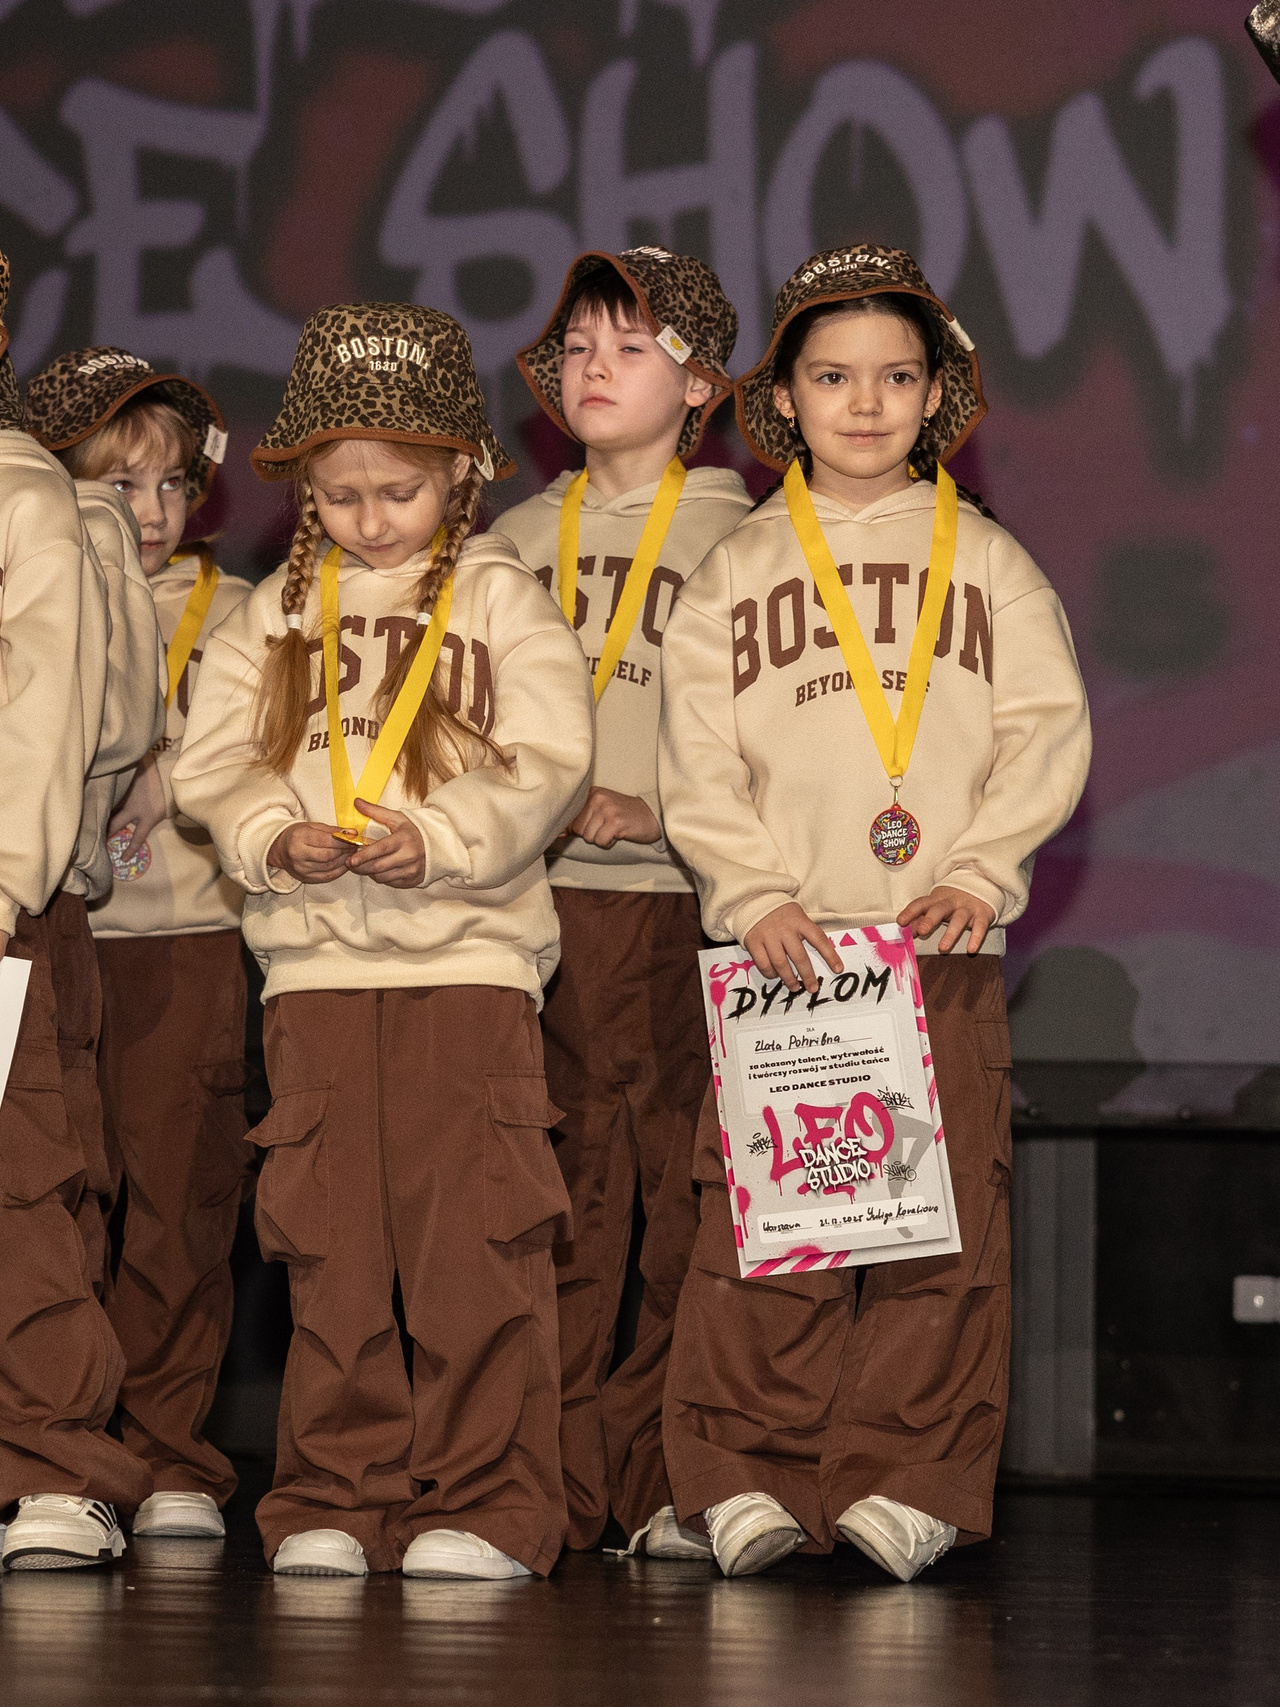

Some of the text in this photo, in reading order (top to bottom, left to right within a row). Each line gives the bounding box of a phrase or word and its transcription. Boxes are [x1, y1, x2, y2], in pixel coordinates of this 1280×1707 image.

[379, 30, 1231, 376] SHOW
[369, 360, 398, 372] 1630
[611, 659, 653, 687] ELF
[880, 828, 908, 840] DANCE
[887, 820, 902, 829] LEO
[882, 837, 906, 848] SHOW
[723, 964, 892, 1024] DYPLOM
[753, 1070, 788, 1080] twórczy
[788, 1064, 819, 1075] rozwój
[828, 1060, 860, 1070] studiu
[861, 1056, 890, 1065] tańca
[760, 1060, 797, 1069] okazany
[797, 1054, 830, 1064] talent,
[830, 1045, 885, 1060] wytrwałość
[769, 1074, 871, 1094] LEO DANCE STUDIO
[798, 1137, 868, 1168] DANCE
[807, 1157, 871, 1191] STUDIO
